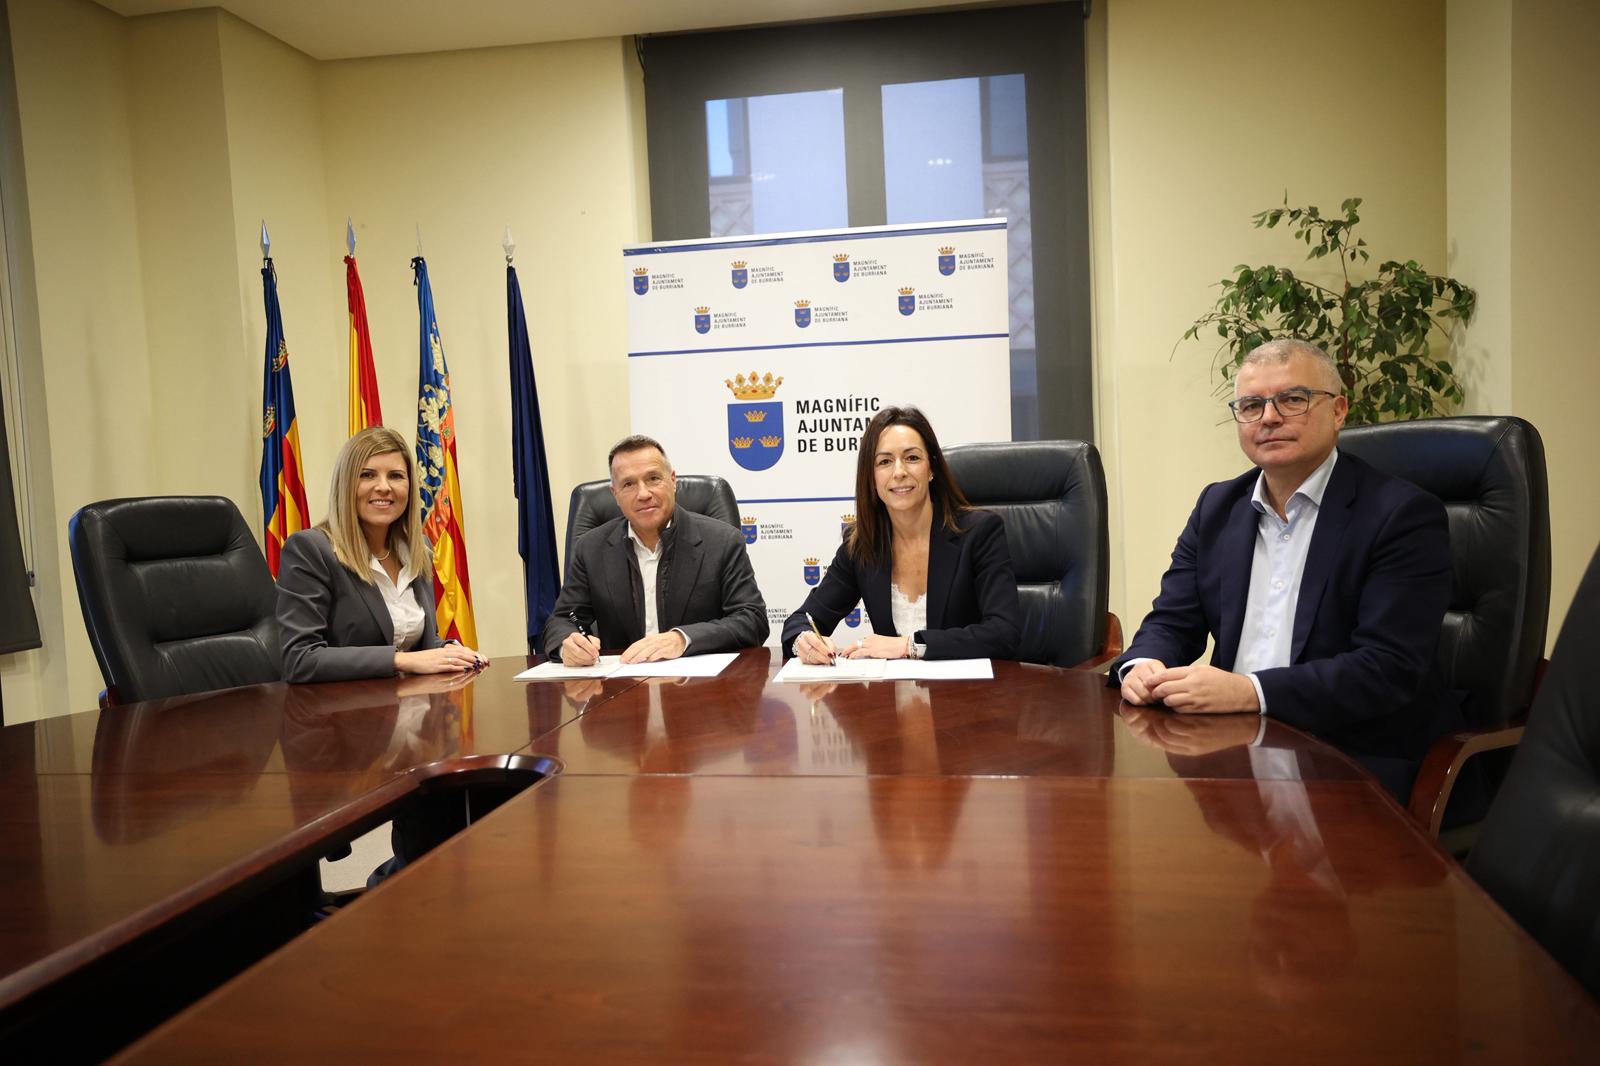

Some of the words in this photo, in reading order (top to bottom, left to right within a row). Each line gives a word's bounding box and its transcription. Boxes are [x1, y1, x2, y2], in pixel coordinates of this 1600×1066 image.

[796, 394, 880, 414] MAGNÍFIC
[798, 417, 871, 433] AJUNTA
[798, 439, 817, 453] DE
